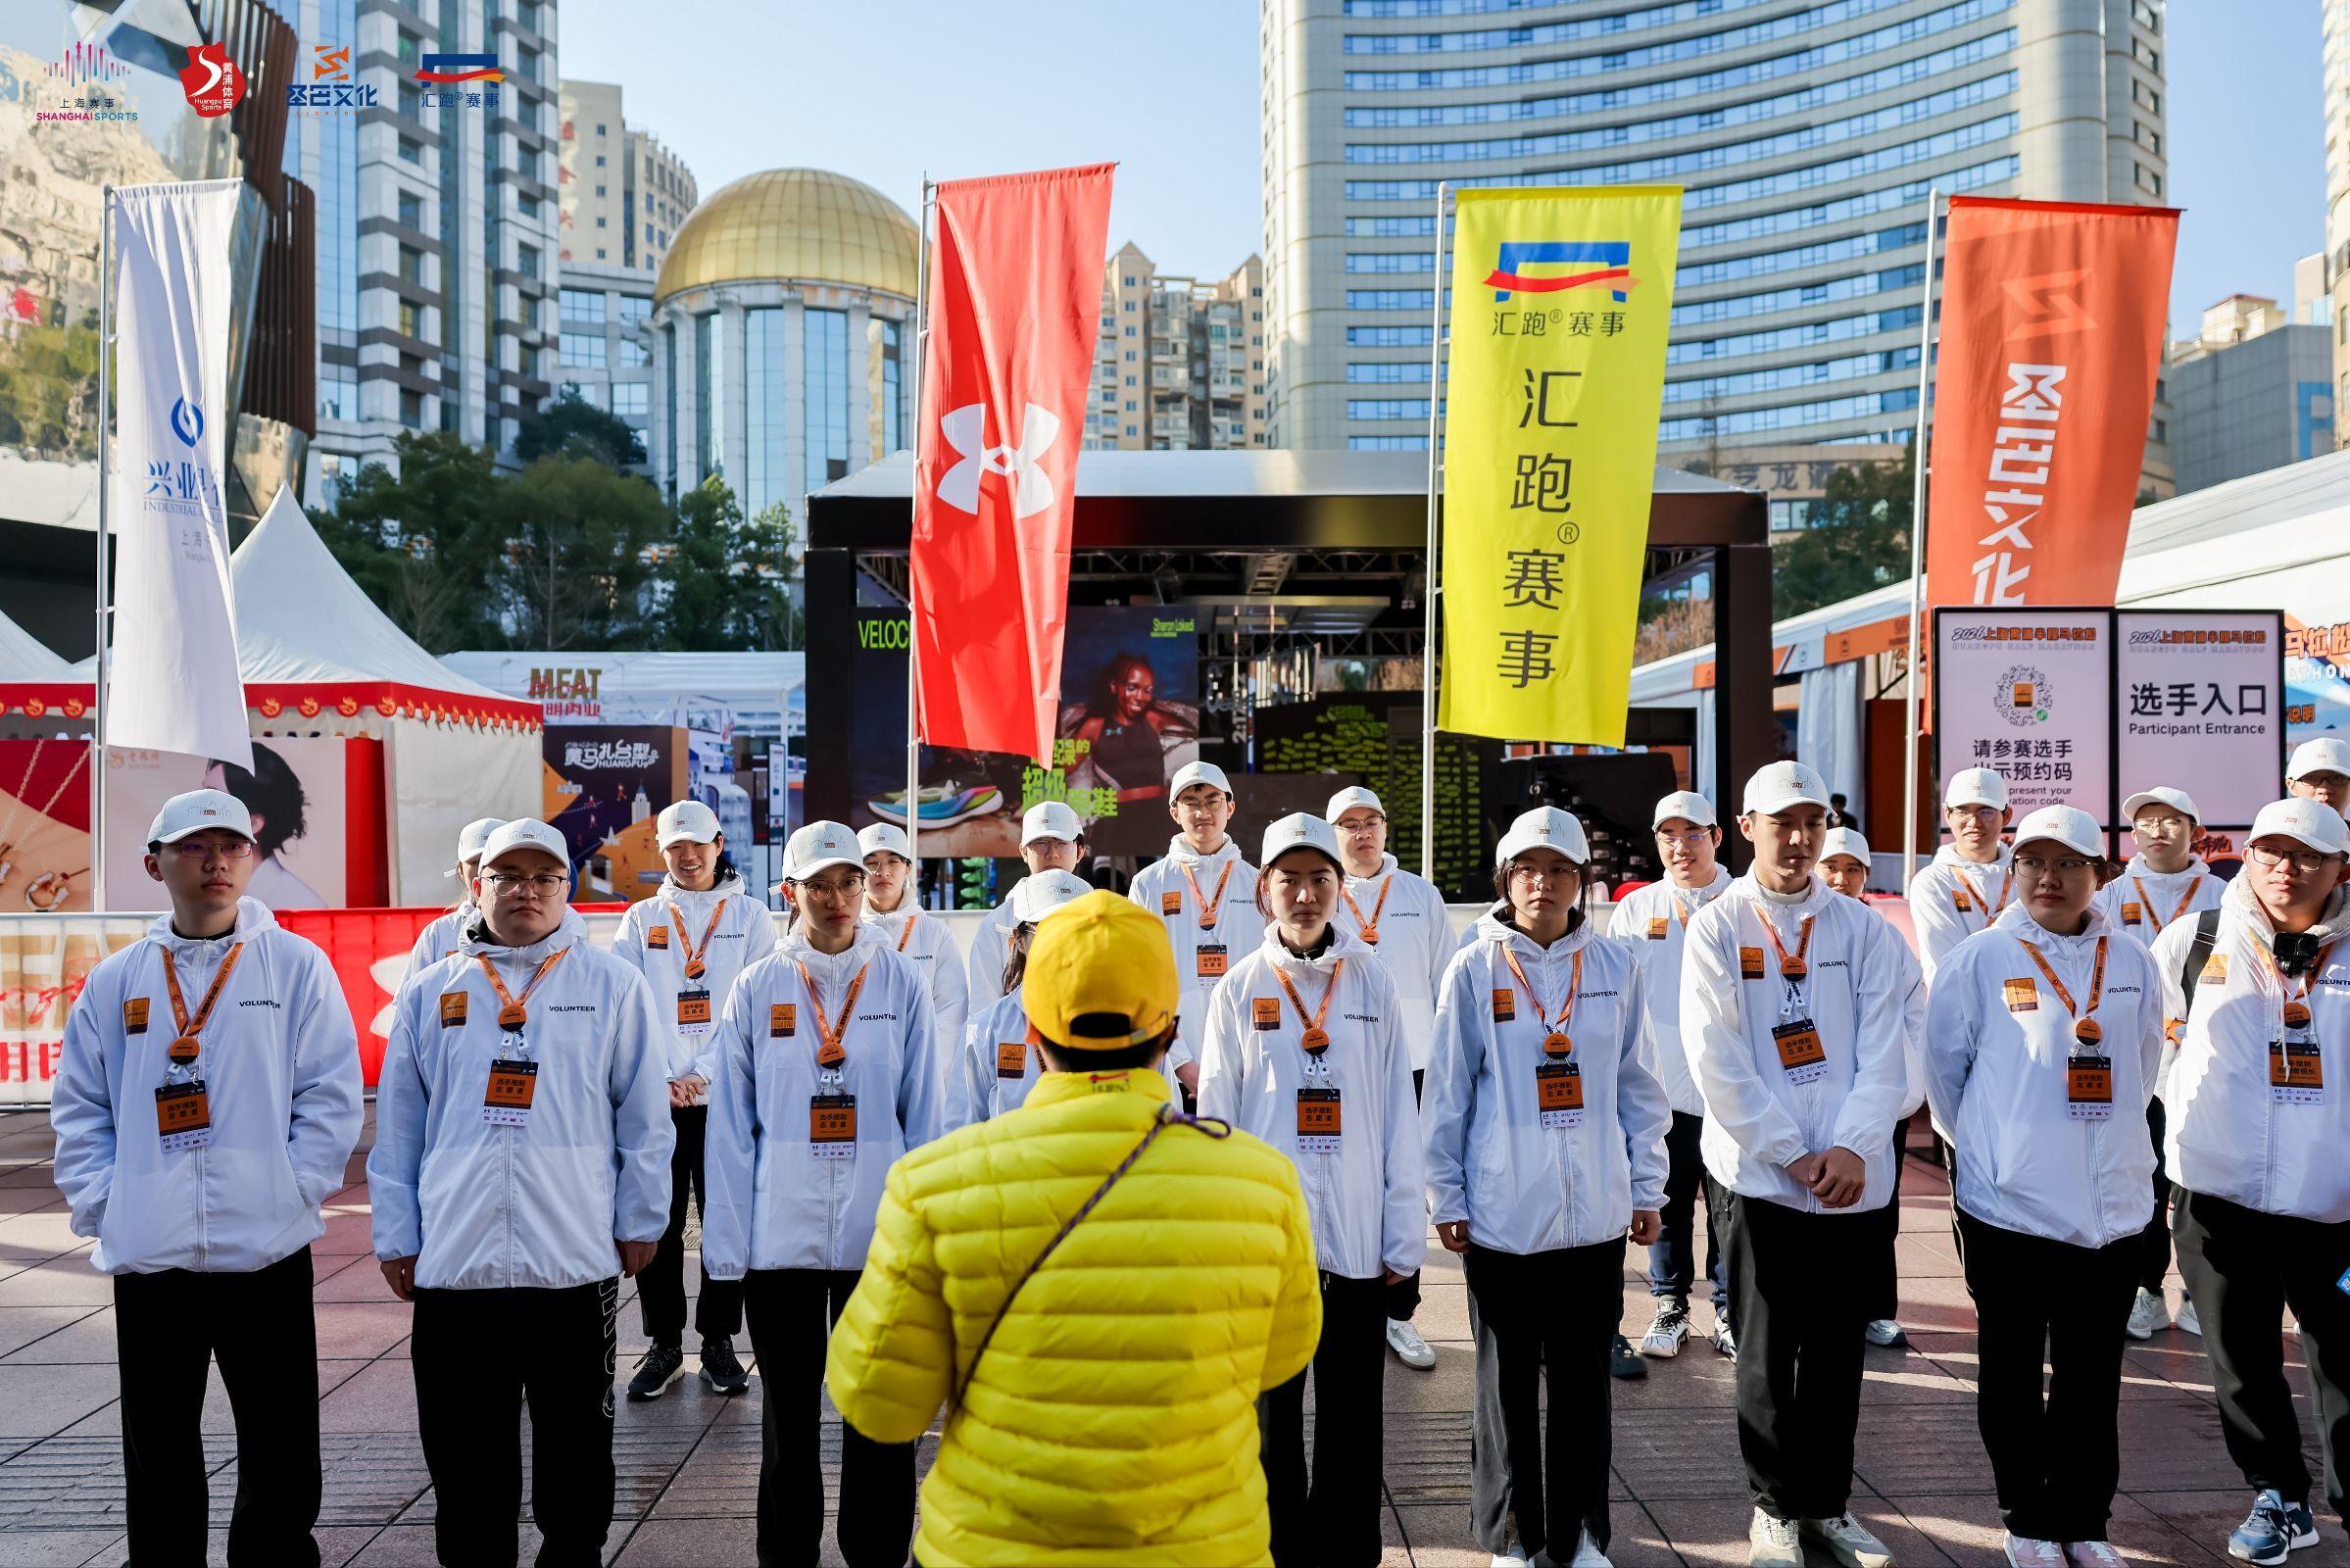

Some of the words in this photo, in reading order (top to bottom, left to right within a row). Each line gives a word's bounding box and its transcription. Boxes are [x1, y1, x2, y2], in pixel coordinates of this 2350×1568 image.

[857, 618, 910, 649] VELOC
[529, 667, 603, 701] MEAT
[2130, 681, 2268, 716] 选手入口
[2284, 704, 2316, 724] 说明
[2129, 721, 2202, 737] Participant
[2205, 721, 2266, 735] Entrance
[1972, 738, 2074, 760] 请参赛选手
[2008, 786, 2047, 797] present
[2049, 786, 2073, 797] your
[2039, 796, 2065, 806] code
[1577, 990, 1619, 1000] VOLUNTEER
